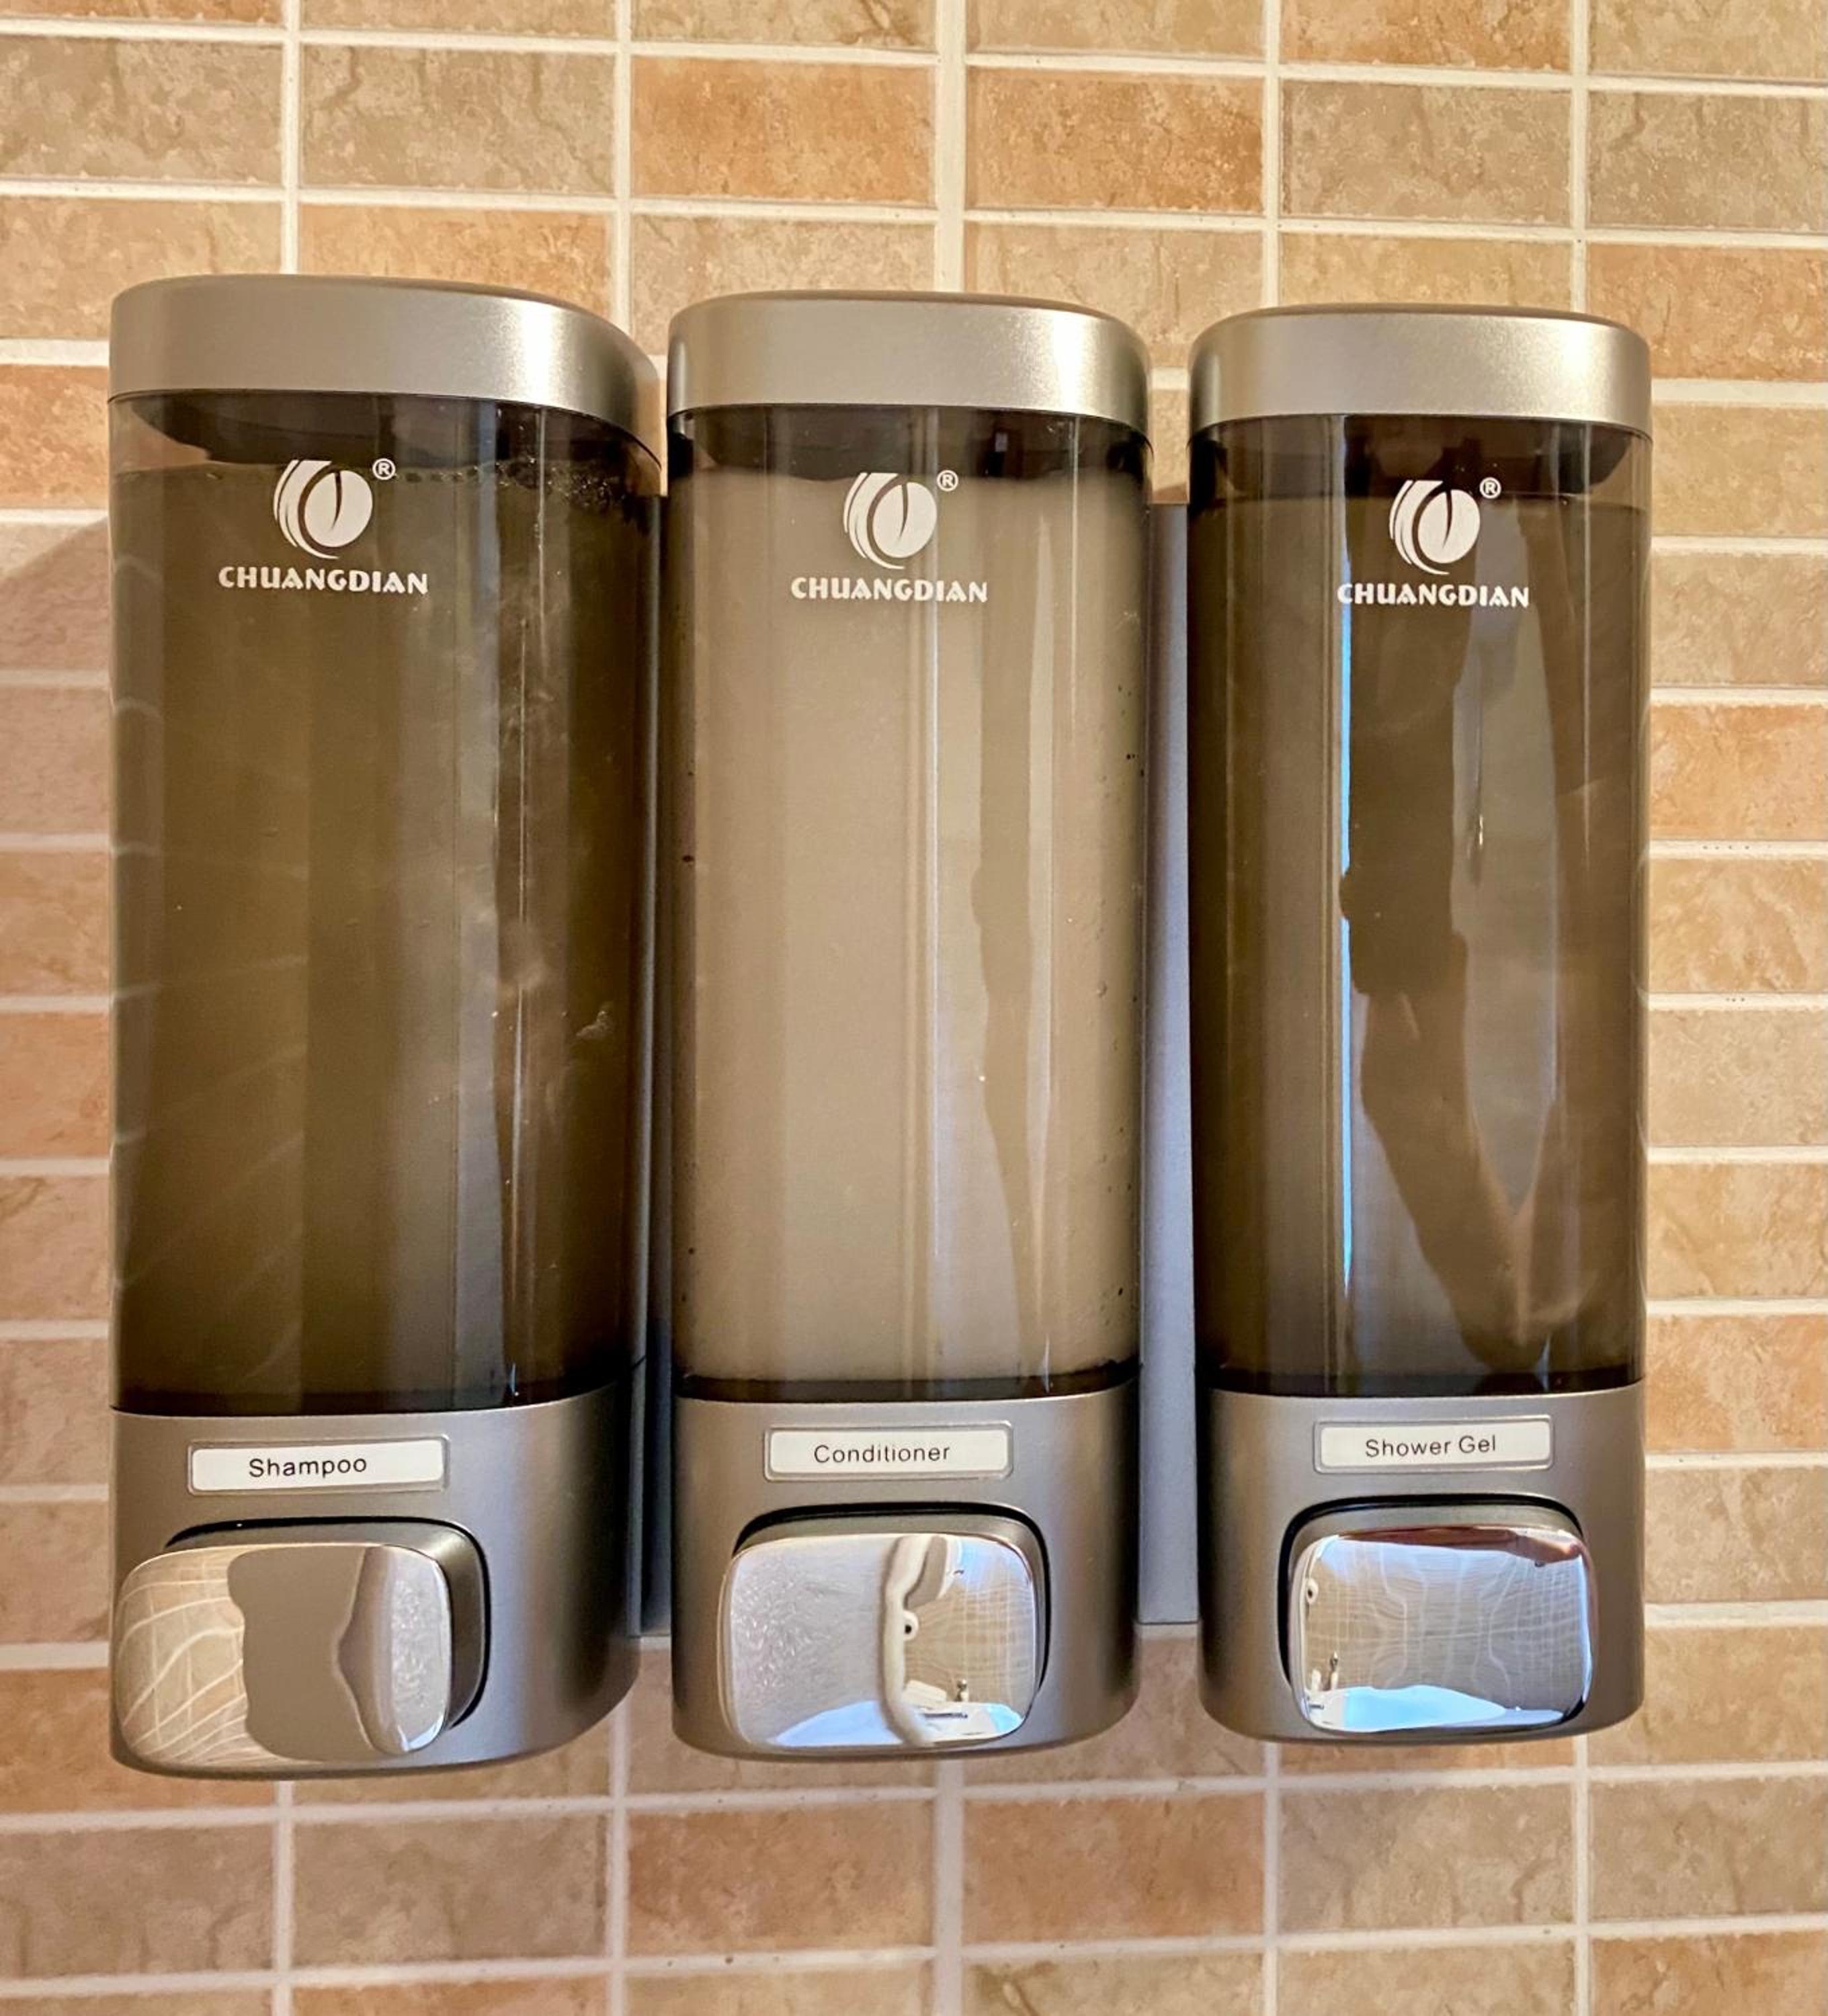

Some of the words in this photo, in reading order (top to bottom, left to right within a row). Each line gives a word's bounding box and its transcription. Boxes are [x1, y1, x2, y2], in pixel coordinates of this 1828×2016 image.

[218, 566, 429, 595] CHUANGDIAN
[790, 576, 989, 604] CHUANGDIAN
[1336, 581, 1530, 609] CHUANGDIAN
[813, 1443, 951, 1464] Conditioner
[1364, 1437, 1451, 1457] Shower
[1458, 1434, 1497, 1454] Gel
[249, 1457, 368, 1478] Shampoo
